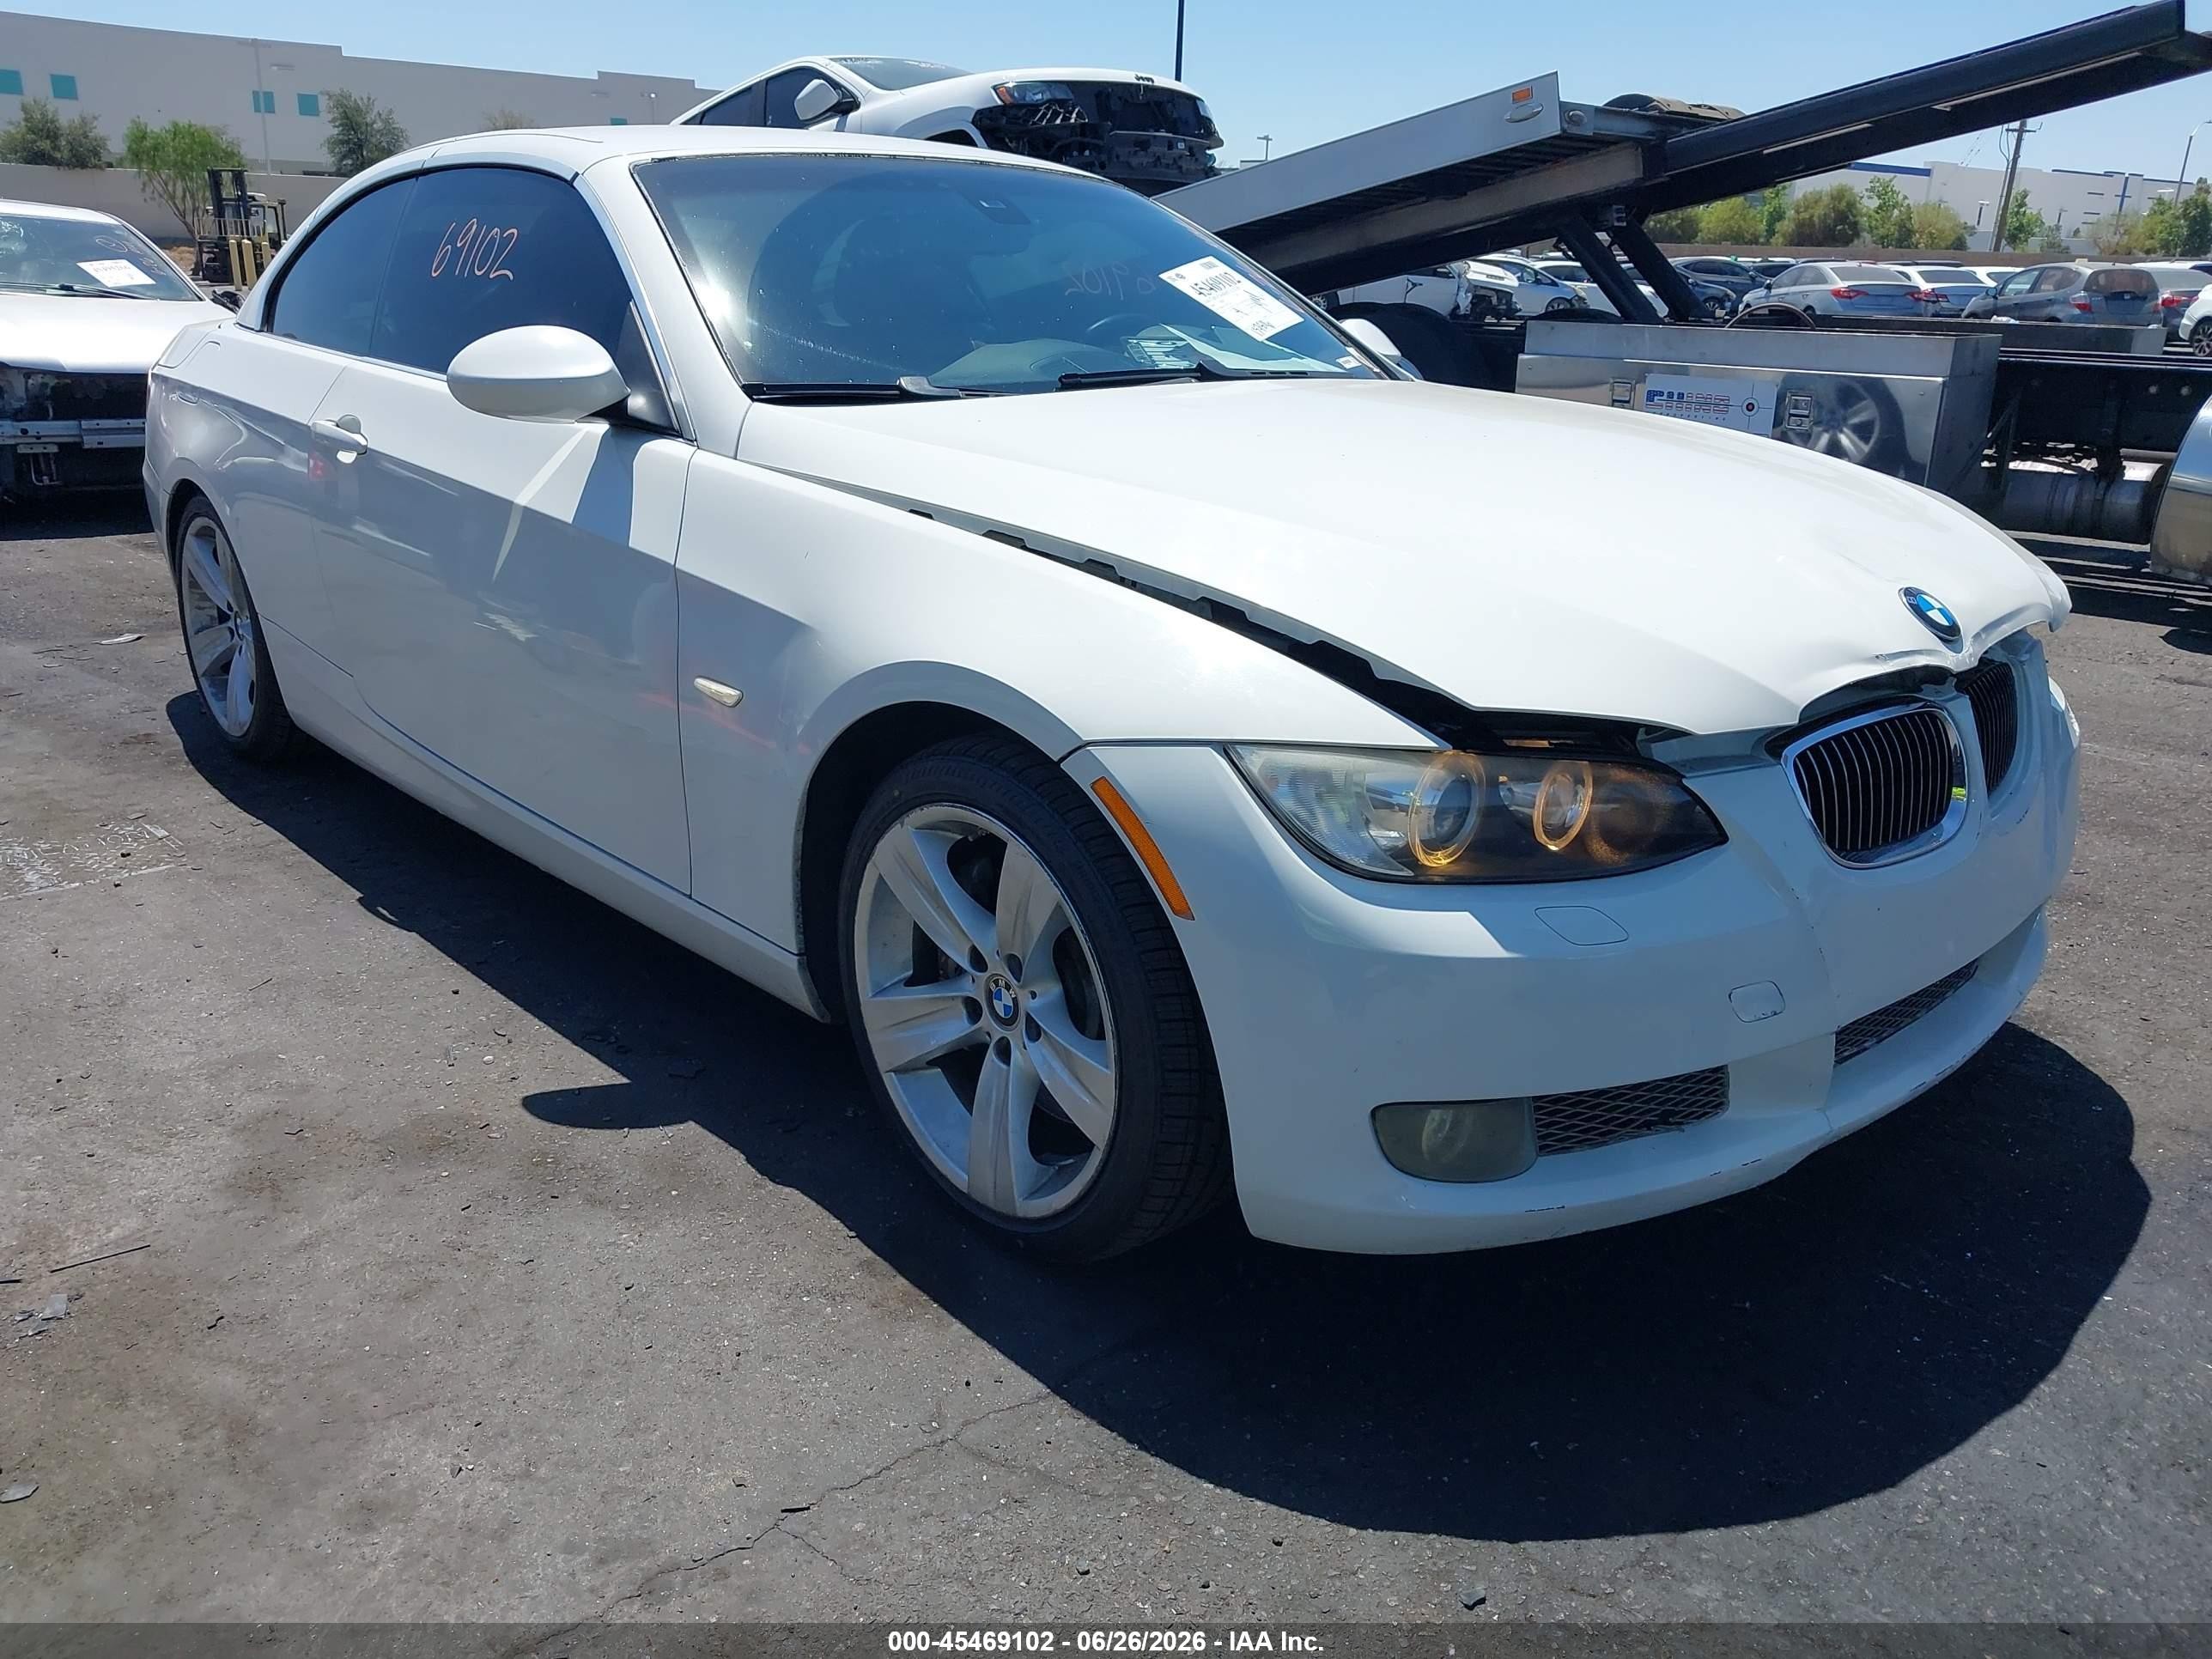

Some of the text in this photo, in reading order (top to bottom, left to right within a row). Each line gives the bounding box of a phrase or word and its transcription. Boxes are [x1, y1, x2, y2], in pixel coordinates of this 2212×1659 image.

[431, 218, 518, 280] 69102
[1188, 271, 1242, 298] 45469102
[989, 979, 1017, 998] BMW
